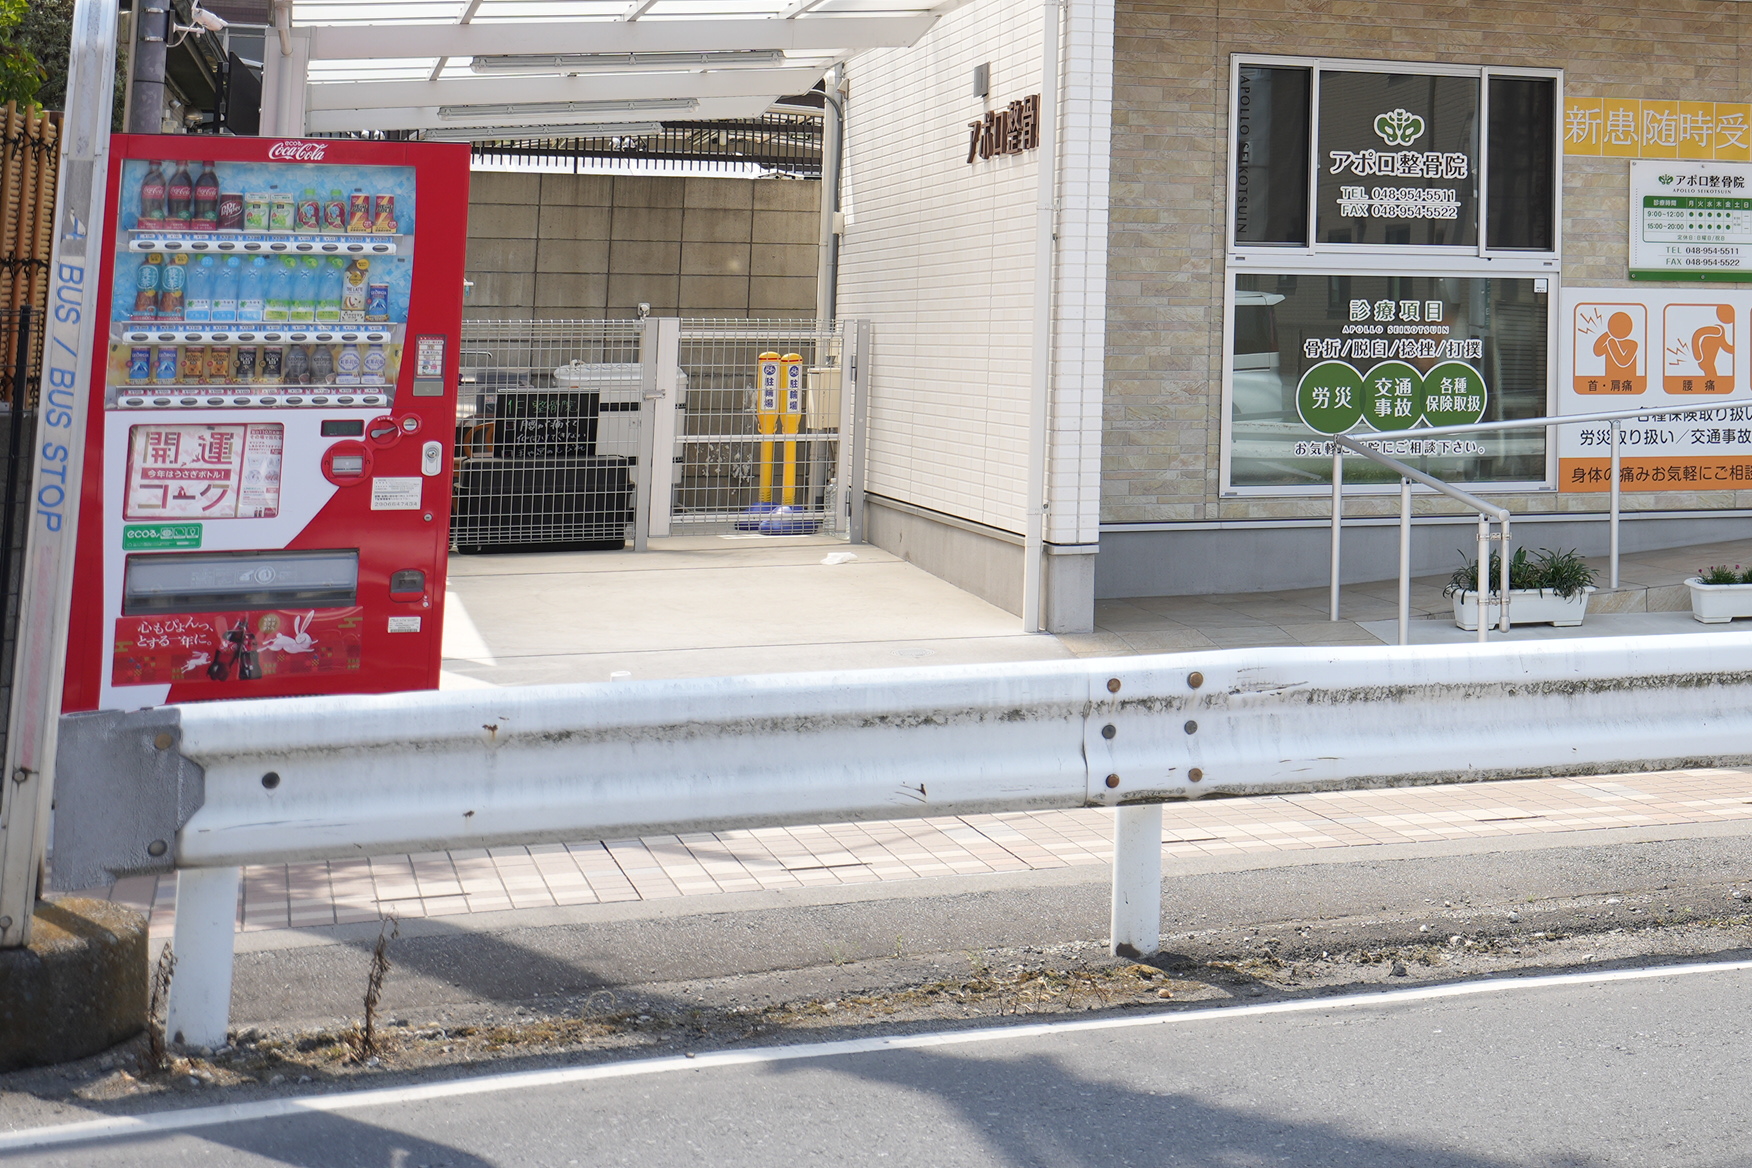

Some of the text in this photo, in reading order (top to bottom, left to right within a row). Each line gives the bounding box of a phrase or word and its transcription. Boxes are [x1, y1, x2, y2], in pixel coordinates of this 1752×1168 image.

[1239, 75, 1250, 135] APOLLO
[967, 93, 1041, 164] アポロ整骨
[1330, 150, 1467, 178] アポロ整骨院
[1676, 174, 1745, 188] アポロ整骨院
[1341, 186, 1368, 200] TEL
[1341, 204, 1368, 217] FAX
[1666, 246, 1682, 254] TEL
[54, 262, 85, 326] BUS
[1349, 300, 1444, 321] 診療項目
[1342, 325, 1383, 334] APOLLO
[1374, 377, 1413, 397] 交通
[1439, 377, 1467, 394] 各種
[46, 366, 75, 429] BUS
[1312, 387, 1352, 409] 労災
[1374, 398, 1412, 417] 事故
[1425, 395, 1481, 412] 保険取扱
[148, 469, 225, 479] 今年はうさぎボトル!
[37, 441, 68, 532] STOP
[138, 484, 230, 512] コーク
